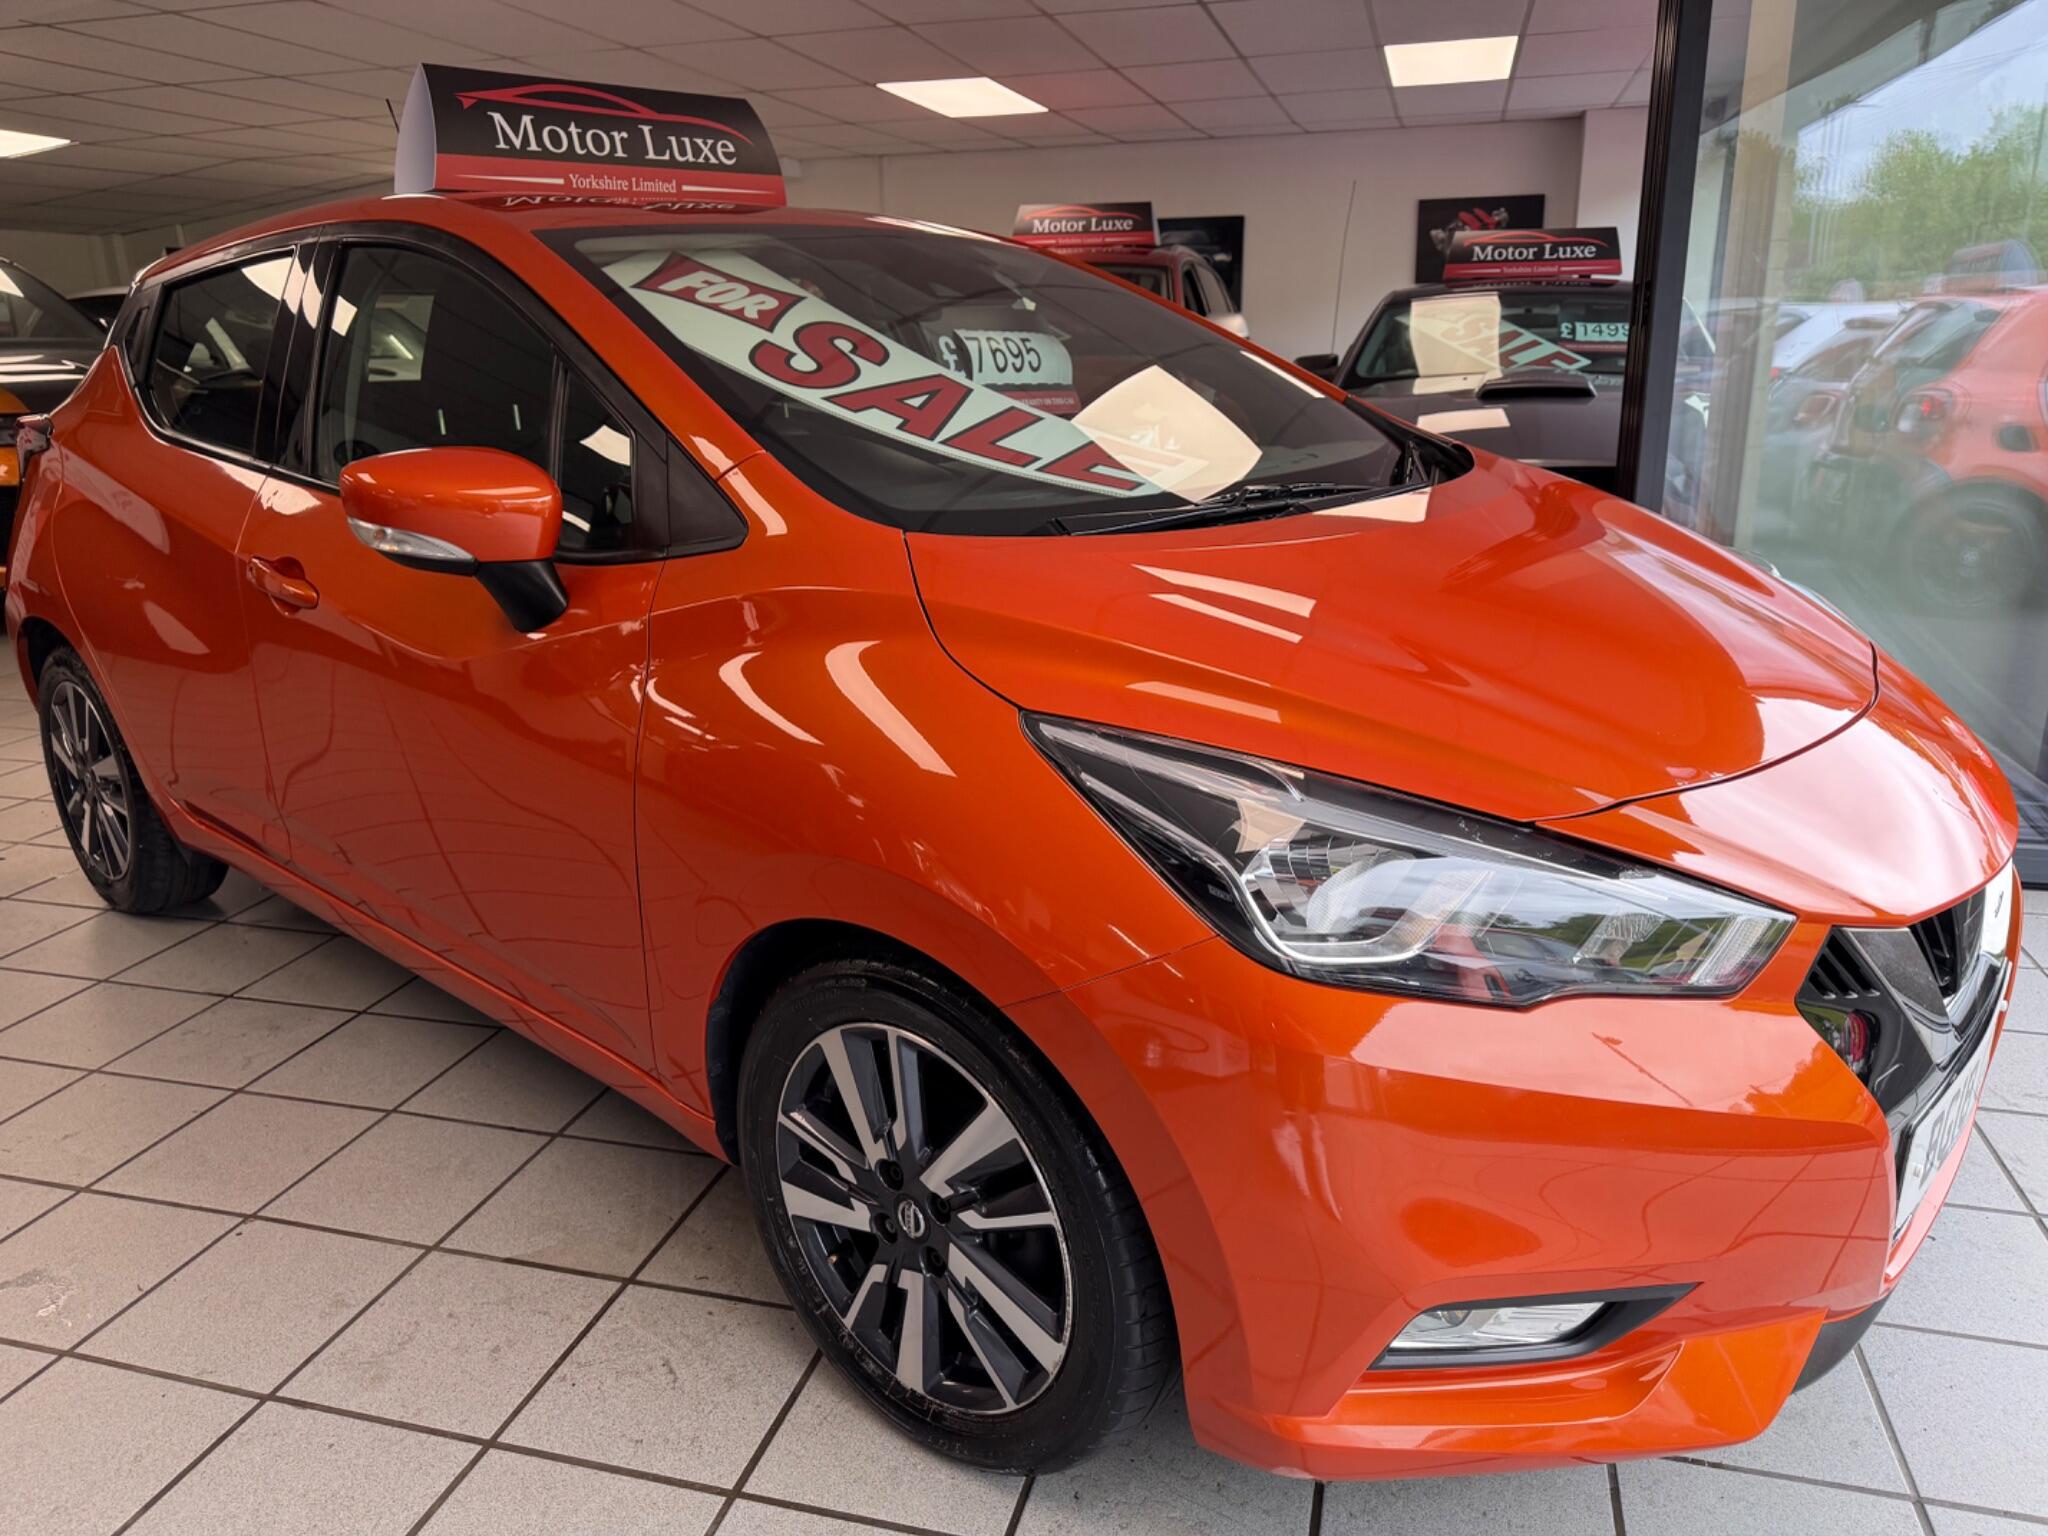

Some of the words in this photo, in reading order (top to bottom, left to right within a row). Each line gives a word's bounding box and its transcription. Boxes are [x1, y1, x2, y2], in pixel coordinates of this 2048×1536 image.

[486, 111, 628, 160] Motor
[637, 125, 737, 166] Luxe
[569, 174, 629, 190] Yorkshire
[632, 177, 677, 194] Limited
[1033, 217, 1085, 233] Motor
[1091, 216, 1134, 231] Luxe
[1472, 245, 1537, 262] Motor
[1543, 243, 1597, 260] Luxe
[659, 269, 778, 320] FOR
[748, 321, 1185, 492] SALE
